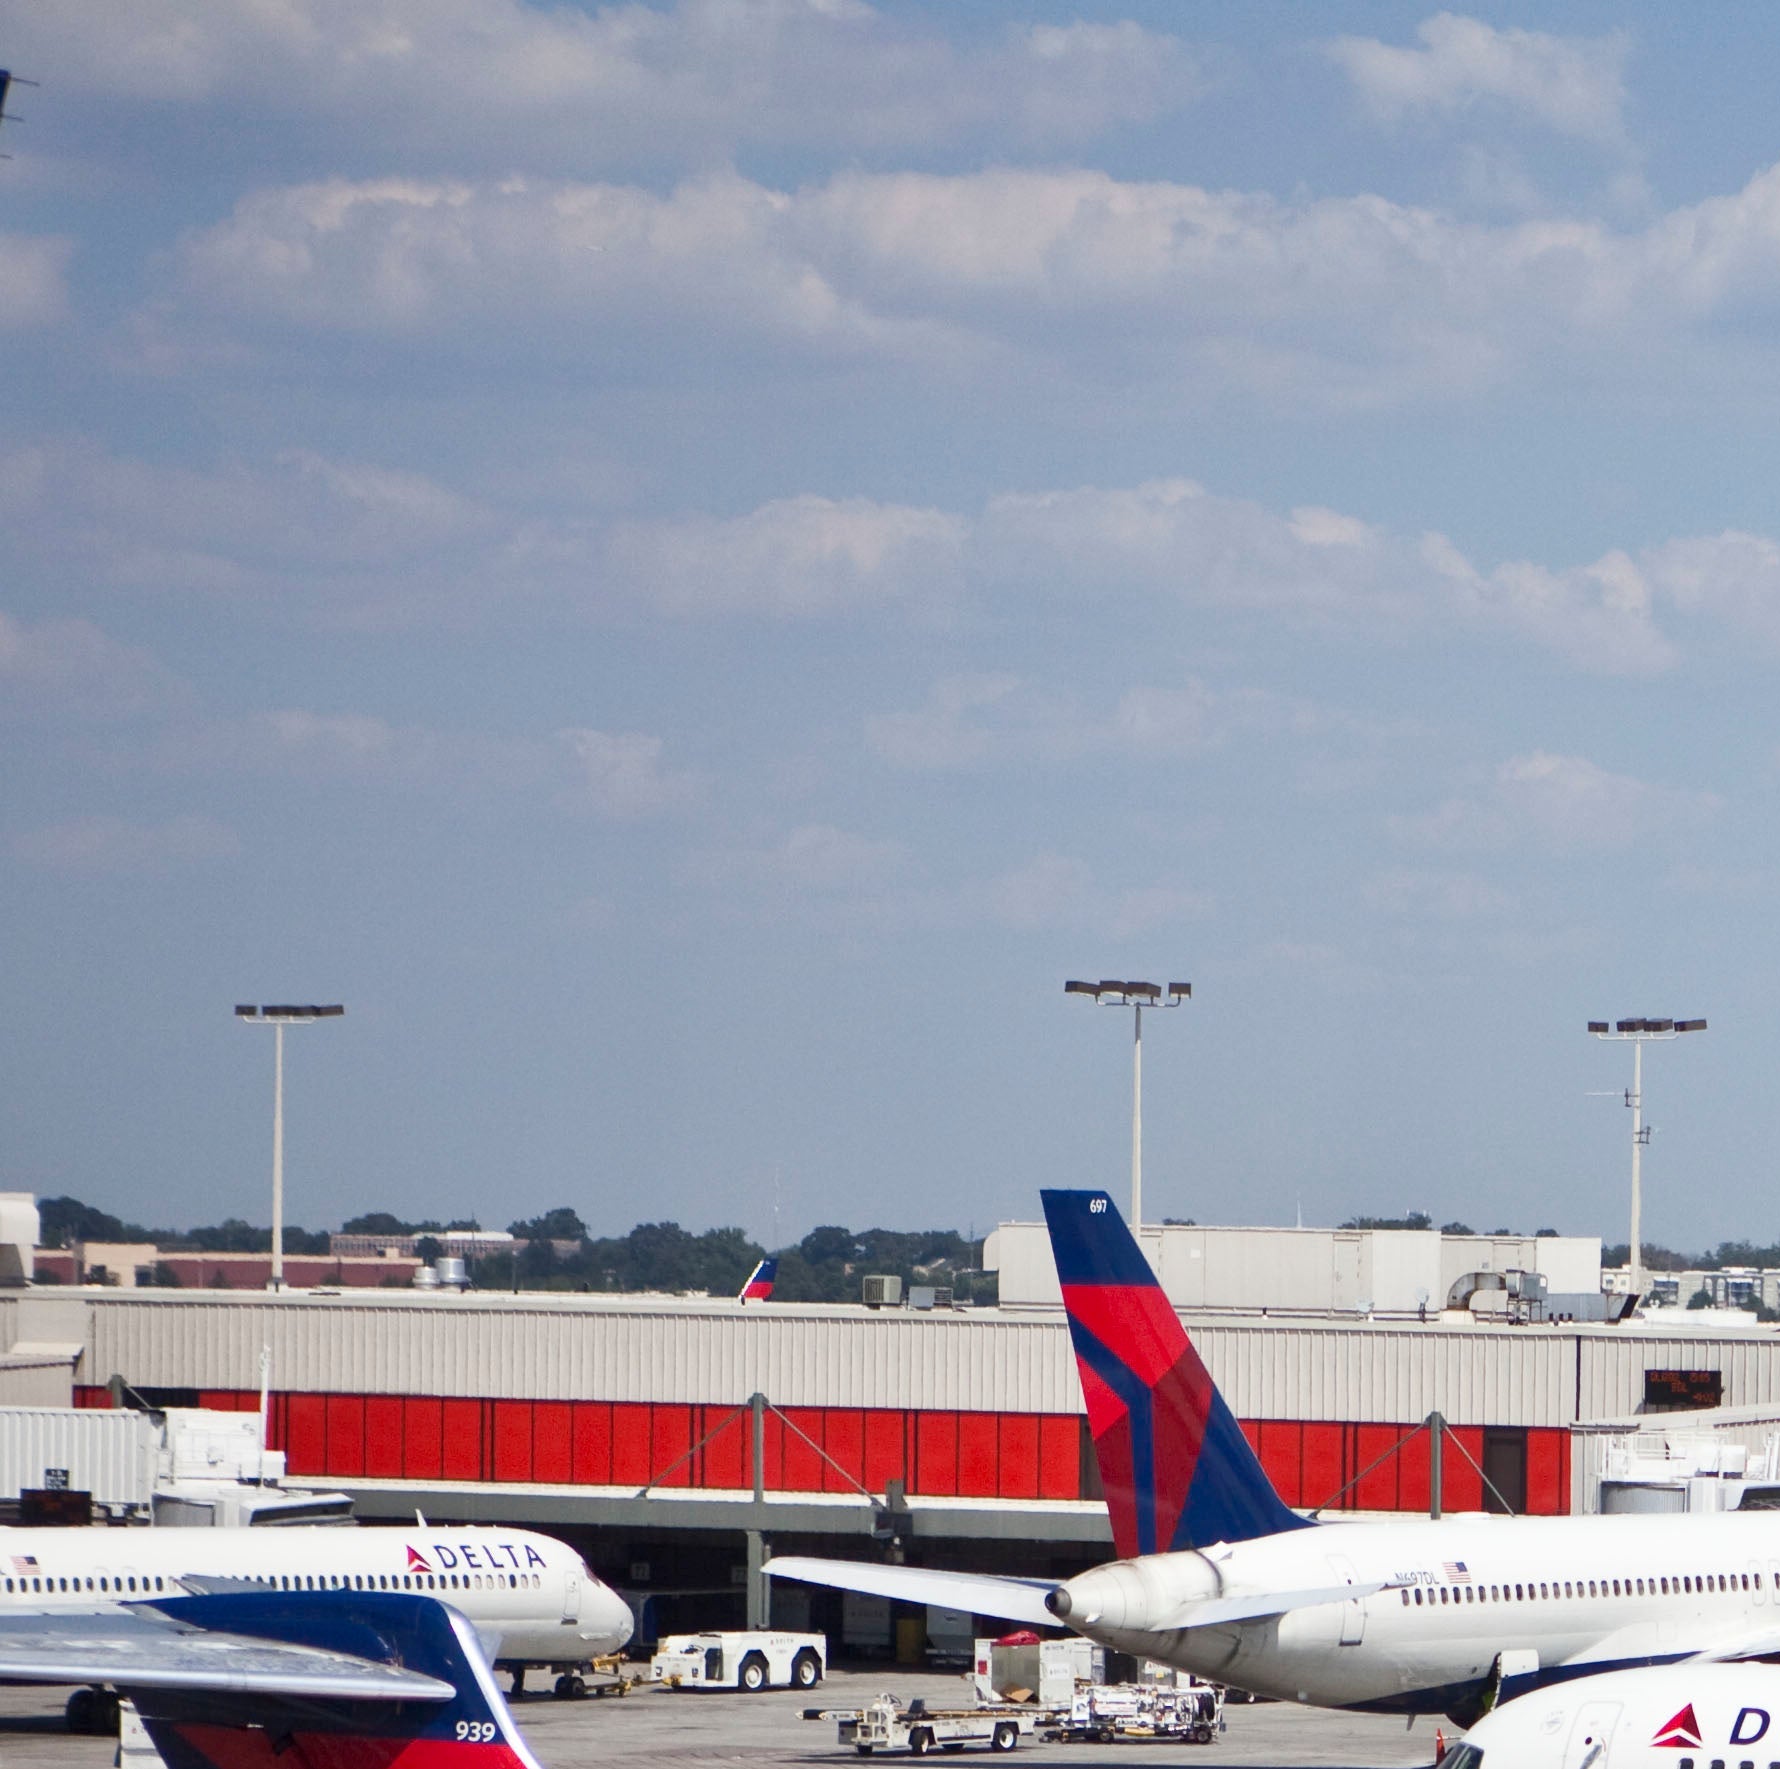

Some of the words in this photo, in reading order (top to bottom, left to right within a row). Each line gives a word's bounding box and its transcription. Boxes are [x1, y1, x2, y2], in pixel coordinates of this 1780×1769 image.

[1090, 1198, 1107, 1214] 697
[433, 1544, 547, 1569] DELTA
[456, 1720, 496, 1742] 939
